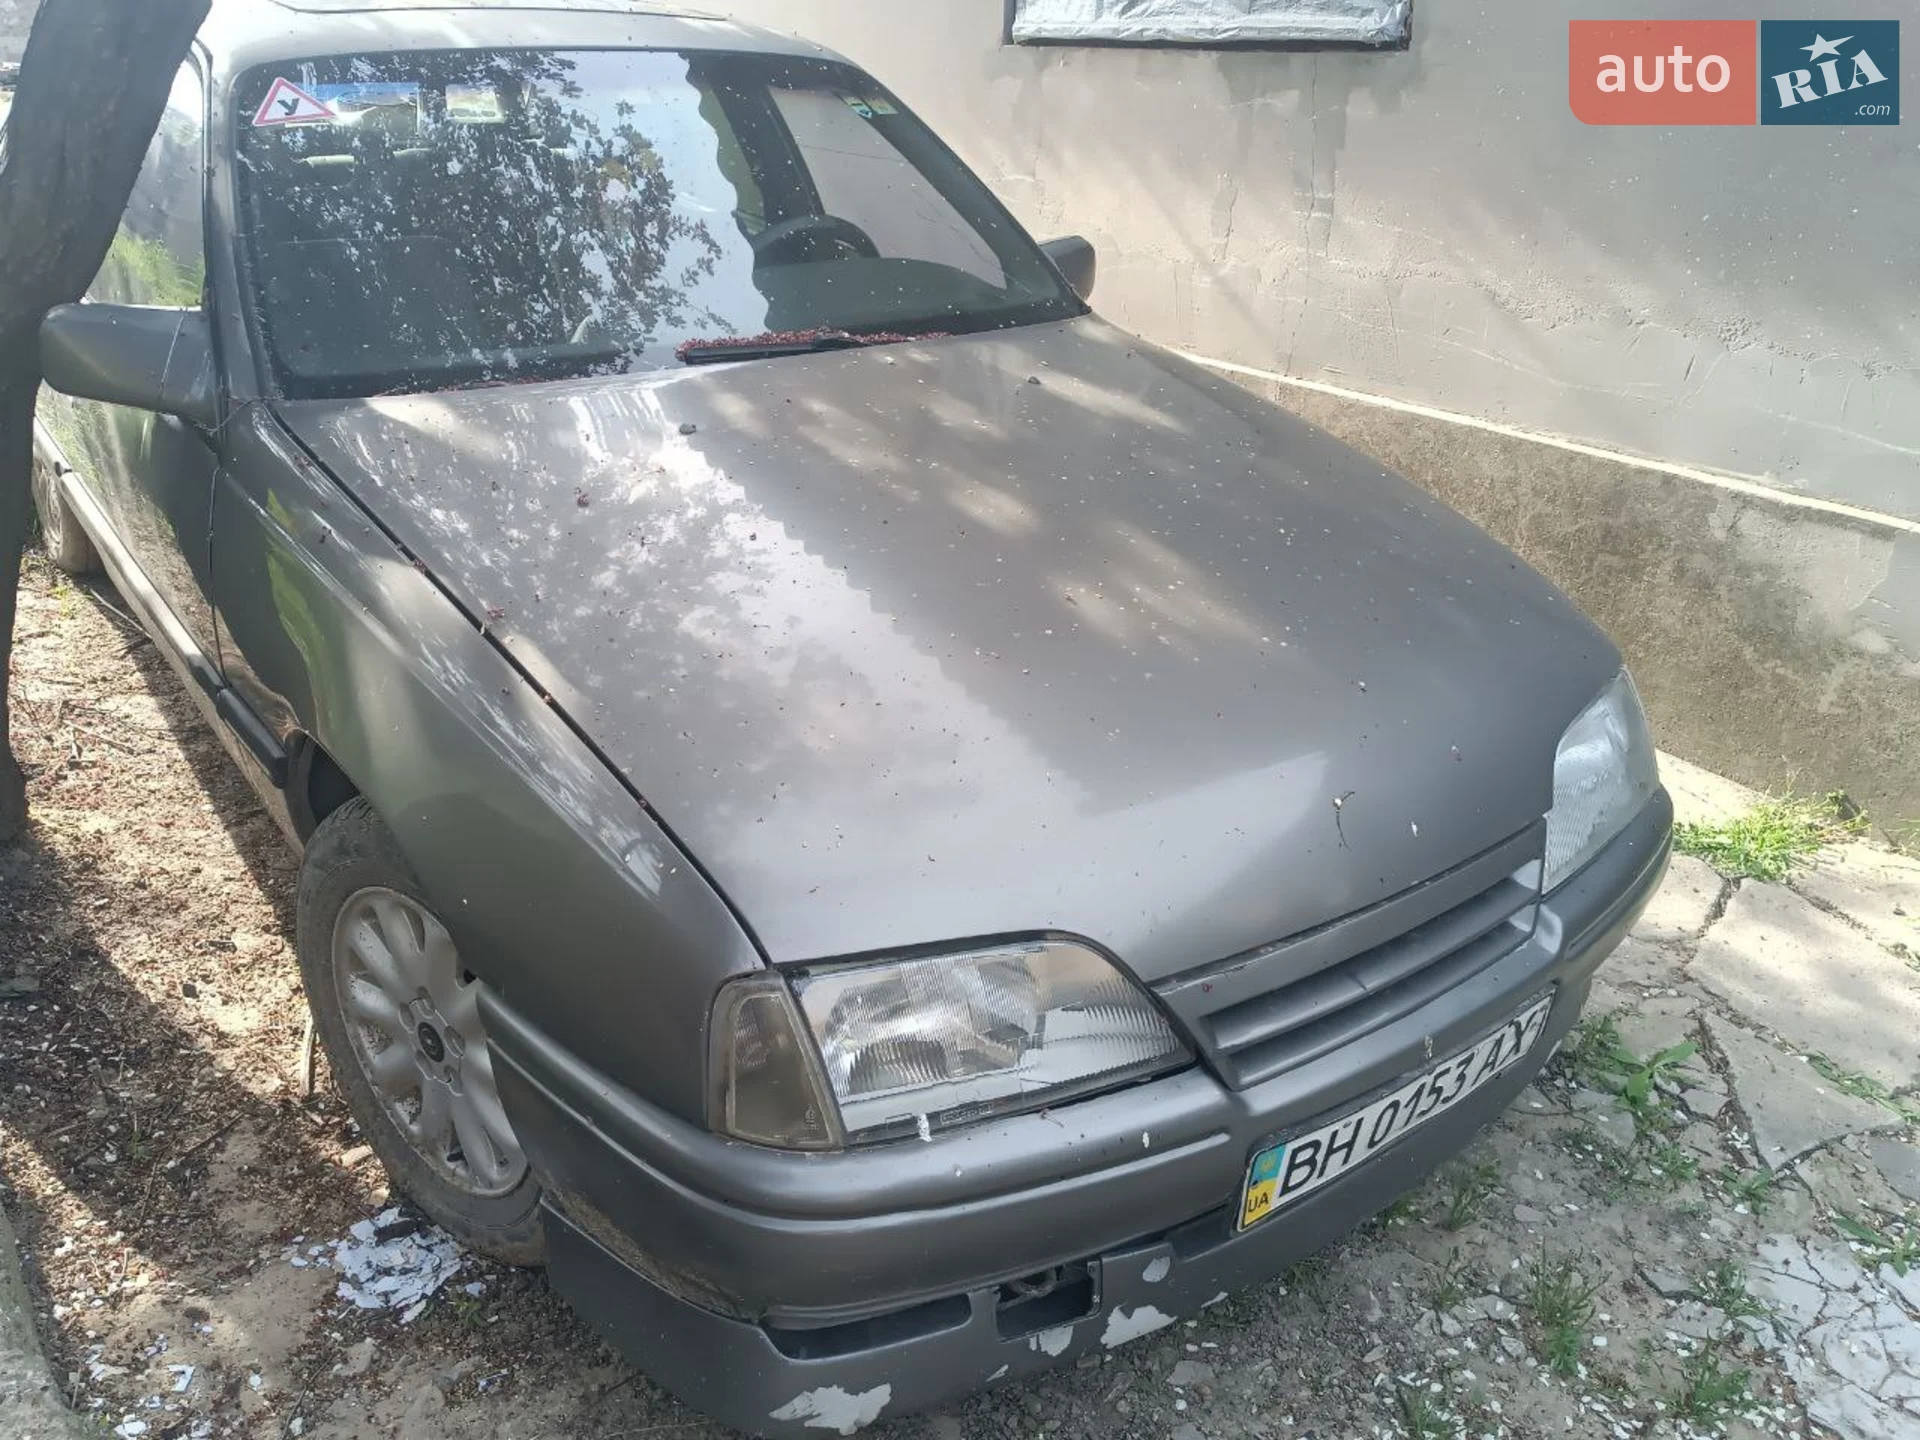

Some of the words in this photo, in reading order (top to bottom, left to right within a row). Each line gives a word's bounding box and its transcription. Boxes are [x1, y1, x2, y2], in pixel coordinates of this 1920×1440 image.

[1279, 1116, 1365, 1198] BH
[1367, 1051, 1476, 1150] 0153
[1471, 1009, 1539, 1085] AX
[1247, 1191, 1269, 1213] UA
